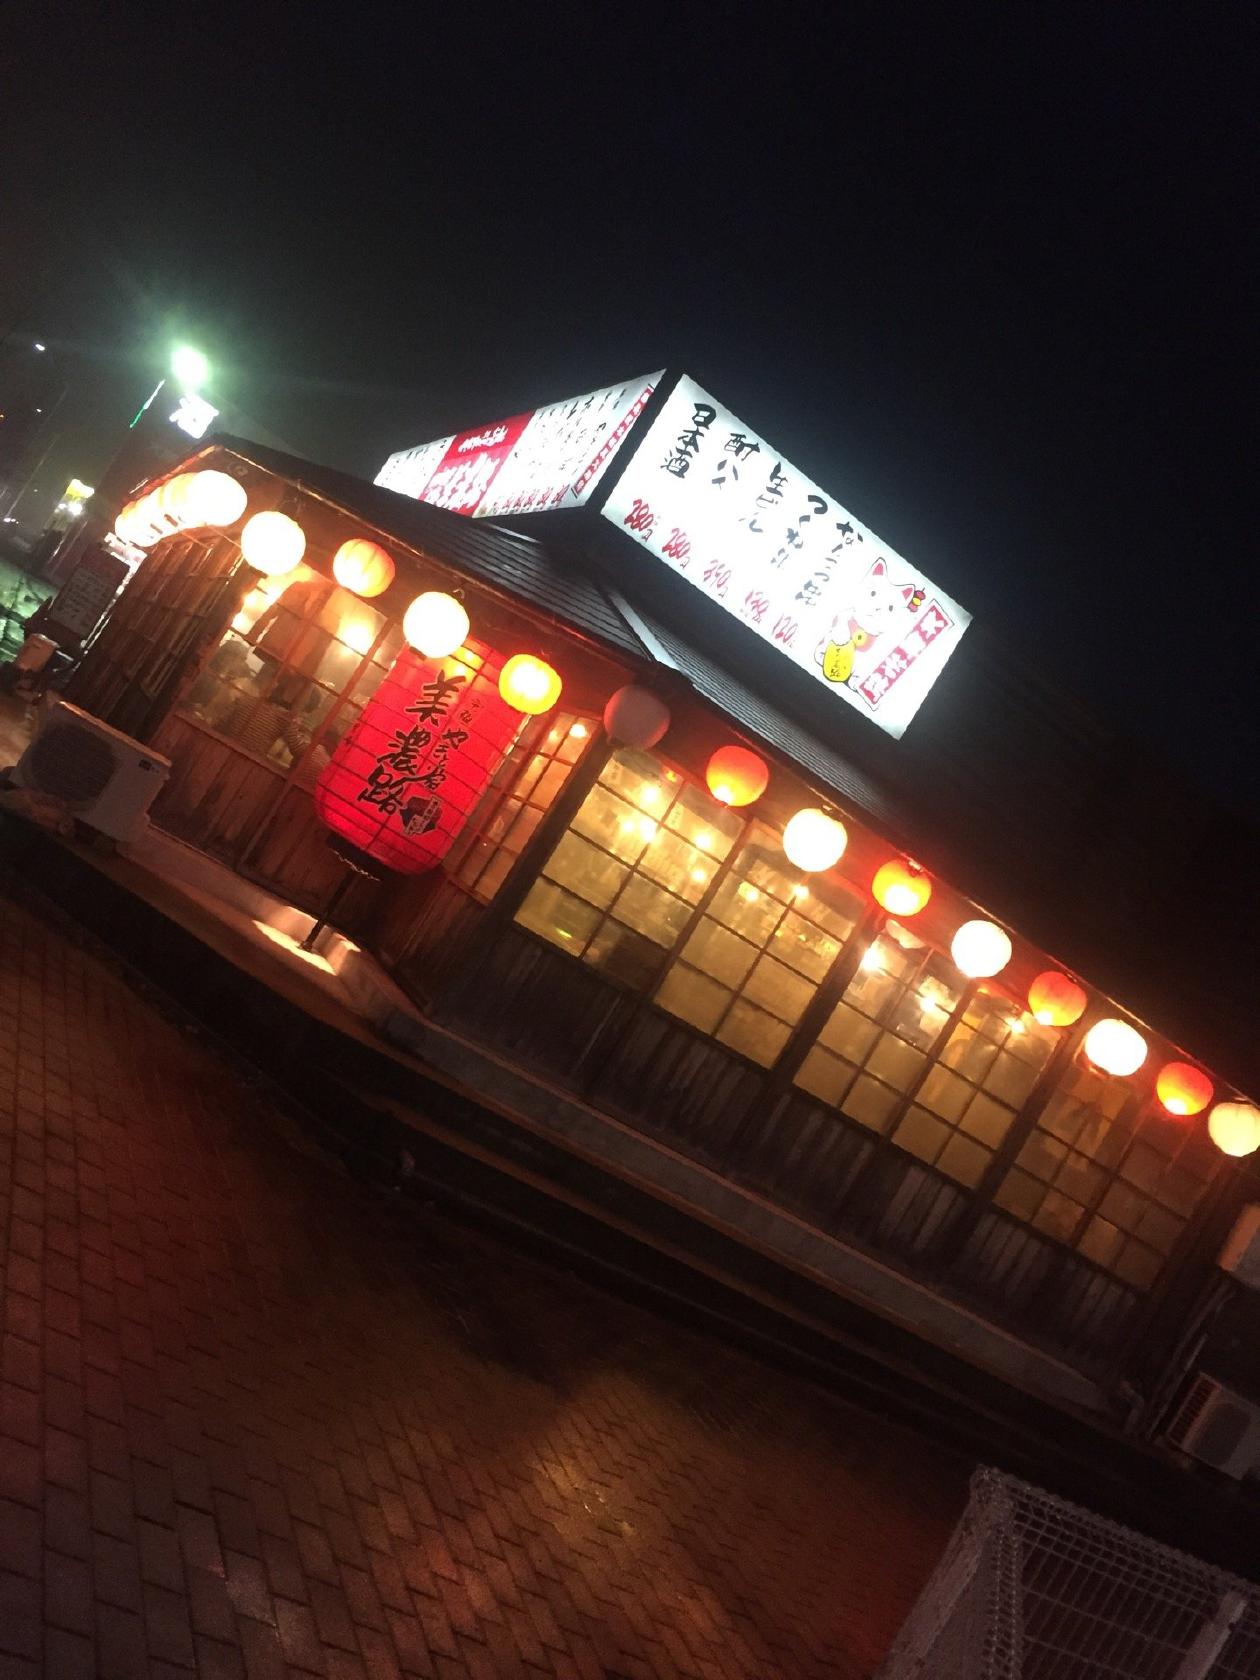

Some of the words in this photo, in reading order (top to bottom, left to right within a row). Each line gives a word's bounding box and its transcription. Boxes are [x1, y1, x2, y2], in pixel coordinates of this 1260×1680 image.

[660, 403, 717, 479] 日本酒
[712, 432, 761, 490] 酎ハイ
[357, 669, 467, 815] 美濃路
